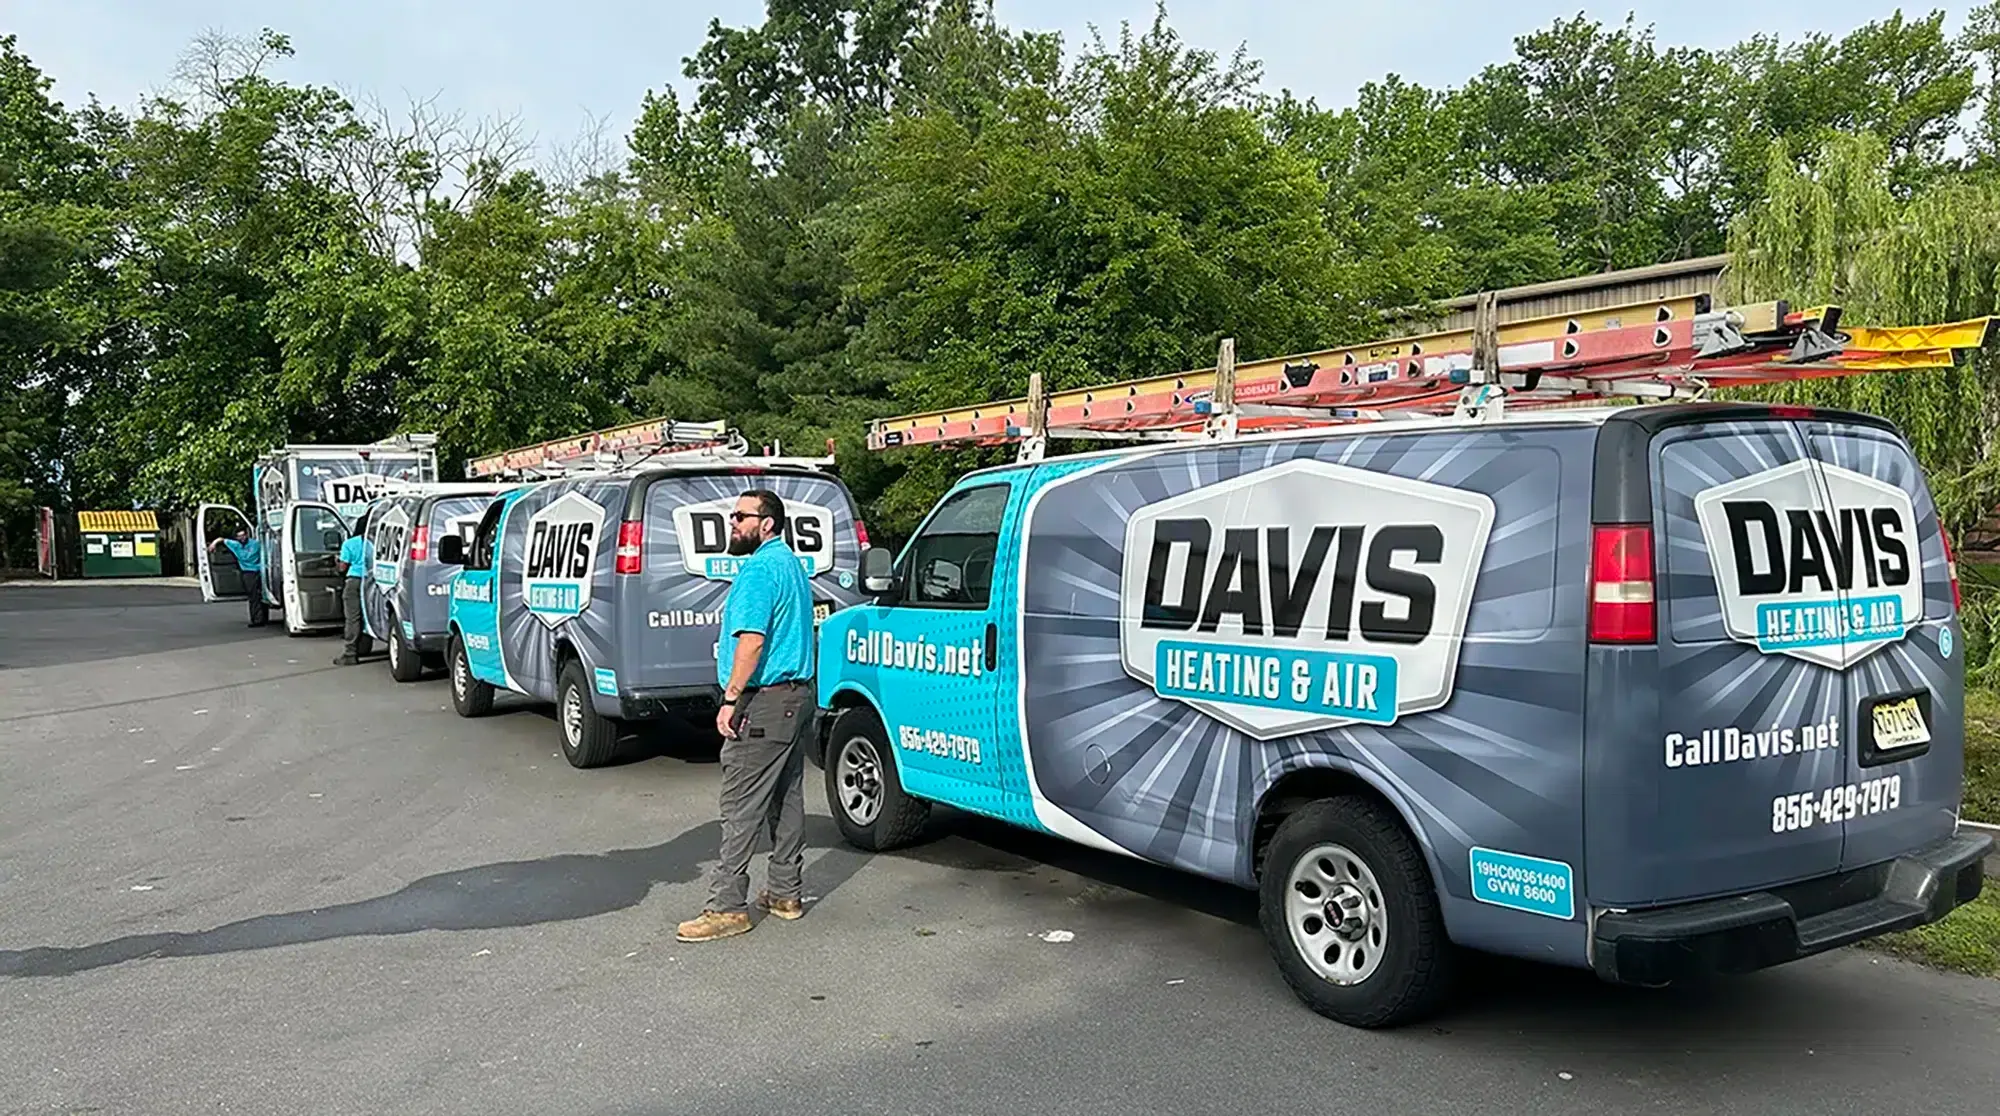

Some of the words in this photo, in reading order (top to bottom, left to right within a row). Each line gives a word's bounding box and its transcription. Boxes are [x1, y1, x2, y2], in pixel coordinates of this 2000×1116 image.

[332, 483, 398, 503] DAV
[527, 521, 594, 578] DAVIS
[689, 512, 823, 553] DIS
[1721, 500, 1910, 596] DAVIS
[1140, 518, 1444, 645] DAVIS
[1765, 604, 1850, 642] HEATING
[1852, 603, 1866, 636] &
[1869, 600, 1900, 633] AIR
[847, 628, 983, 677] CallDavis.net
[1166, 648, 1281, 700] HEATING
[1291, 658, 1313, 703] &
[1321, 661, 1379, 712] AIR
[1664, 714, 1840, 768] CallDavis.net
[1476, 860, 1566, 890] 19HC00361400
[1487, 877, 1520, 897] GVW
[1523, 884, 1556, 904] 8600
